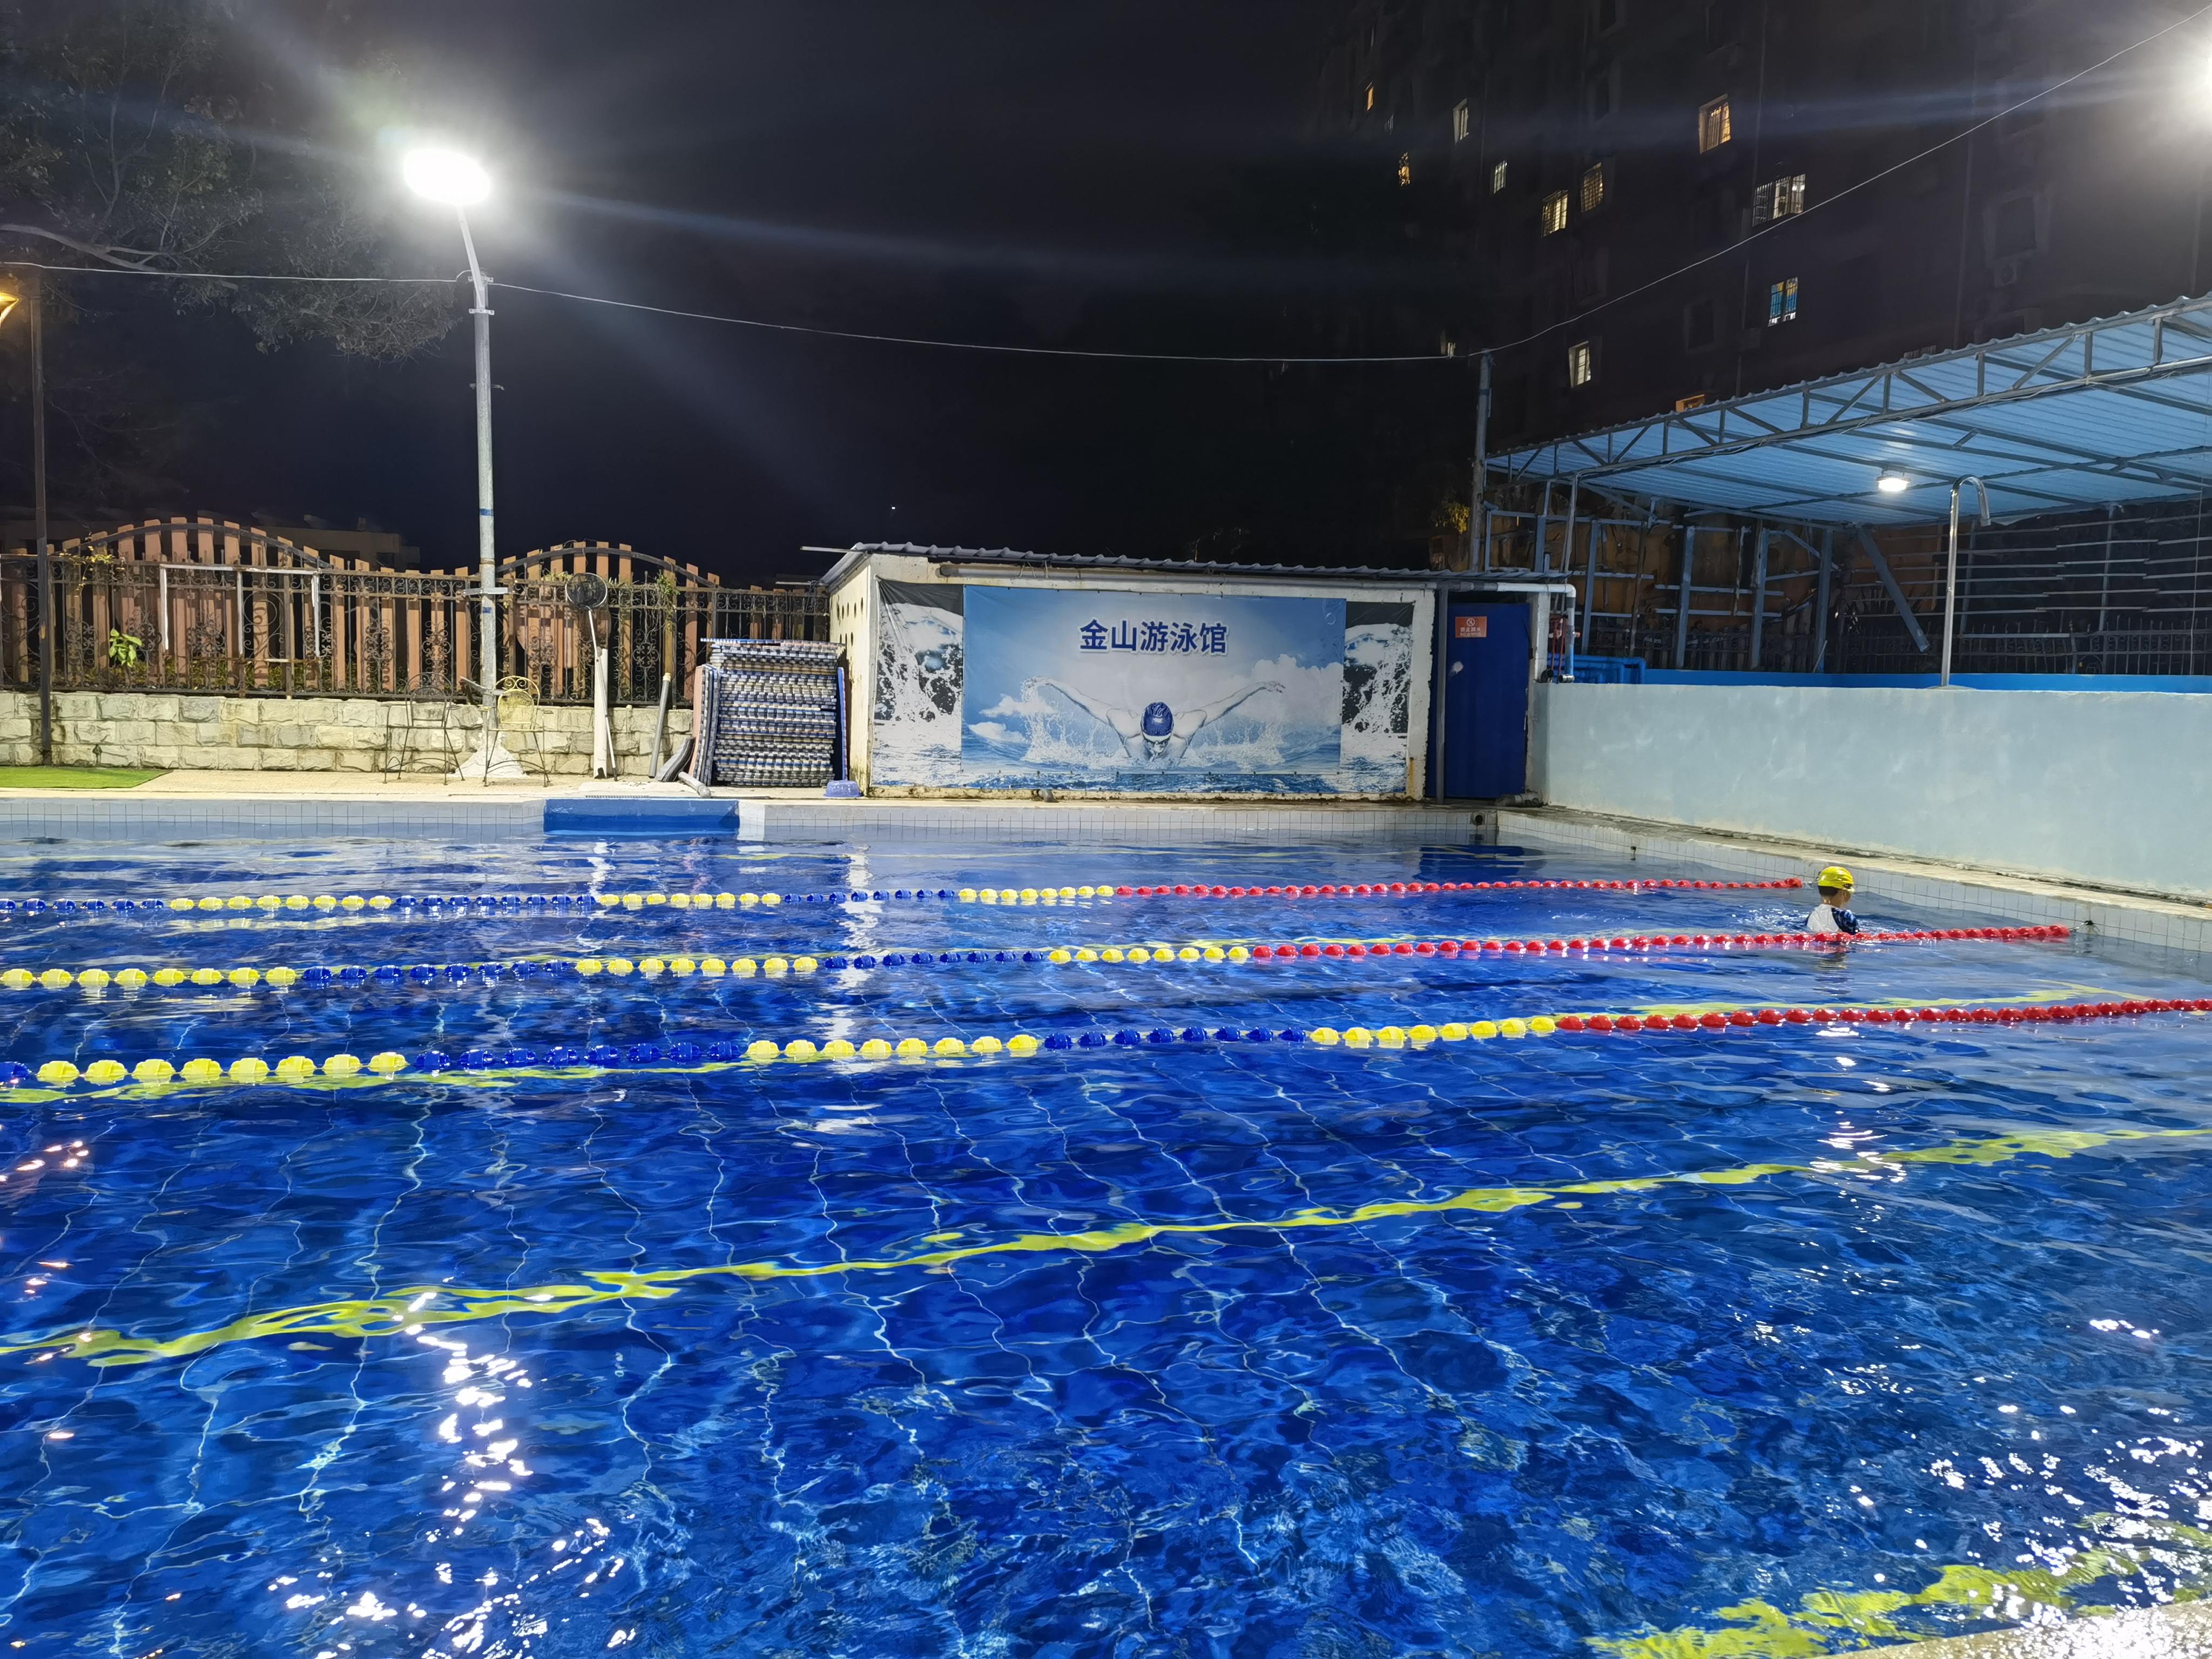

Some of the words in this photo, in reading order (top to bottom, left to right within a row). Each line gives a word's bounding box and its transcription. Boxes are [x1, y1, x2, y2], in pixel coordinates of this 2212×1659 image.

[1080, 619, 1227, 653] 金山游泳馆
